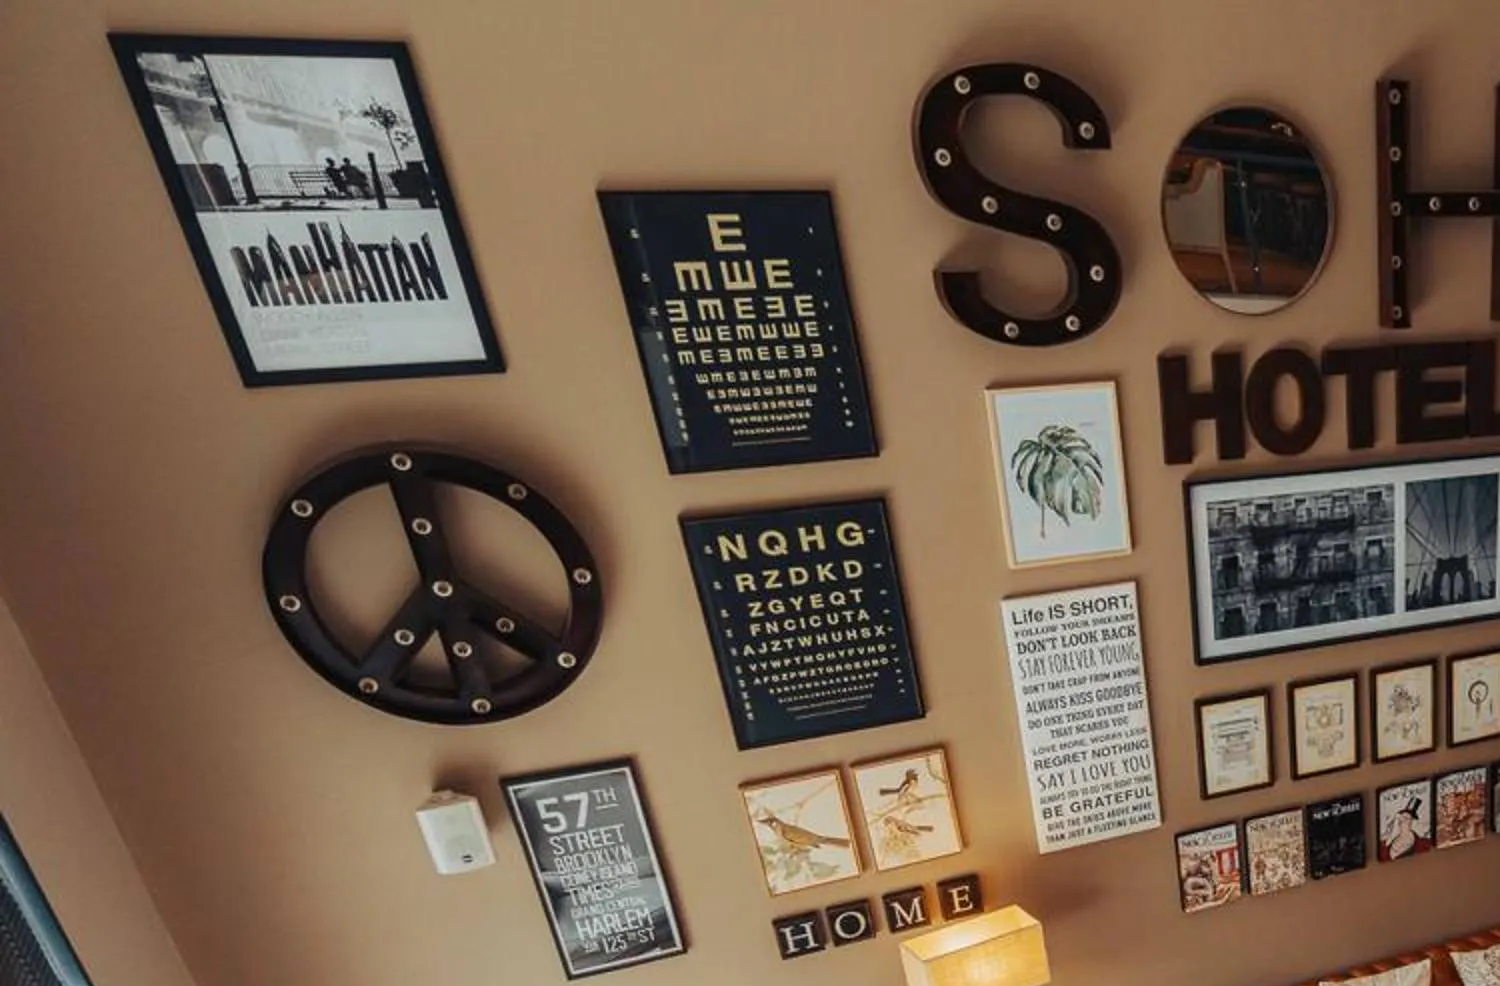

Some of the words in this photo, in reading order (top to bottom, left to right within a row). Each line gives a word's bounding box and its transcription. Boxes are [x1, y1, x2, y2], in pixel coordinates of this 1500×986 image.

[231, 217, 448, 307] MANHATTAN
[1011, 608, 1045, 625] Life
[1048, 603, 1065, 620] IS
[1017, 637, 1057, 655] DON'T
[1061, 630, 1099, 648] LOOK
[1101, 624, 1137, 641] BACK
[1018, 656, 1046, 679] STAY
[1048, 648, 1097, 675] FOREVER
[1026, 695, 1067, 714] ALWAYS
[1069, 690, 1094, 707] KISS
[1095, 681, 1143, 702] GOODBYE
[1033, 750, 1087, 771] REGRET
[1092, 738, 1149, 760] NOTHING
[1036, 772, 1064, 791] SAY
[1081, 761, 1118, 783] LOVE
[1122, 754, 1151, 773] YOU
[1042, 804, 1064, 820] BE
[1069, 786, 1153, 814] GRATEFUL
[548, 823, 625, 855] STREET
[553, 842, 633, 875] BROOKLYN
[575, 907, 654, 941] HARLEM
[780, 884, 974, 954] HOME
